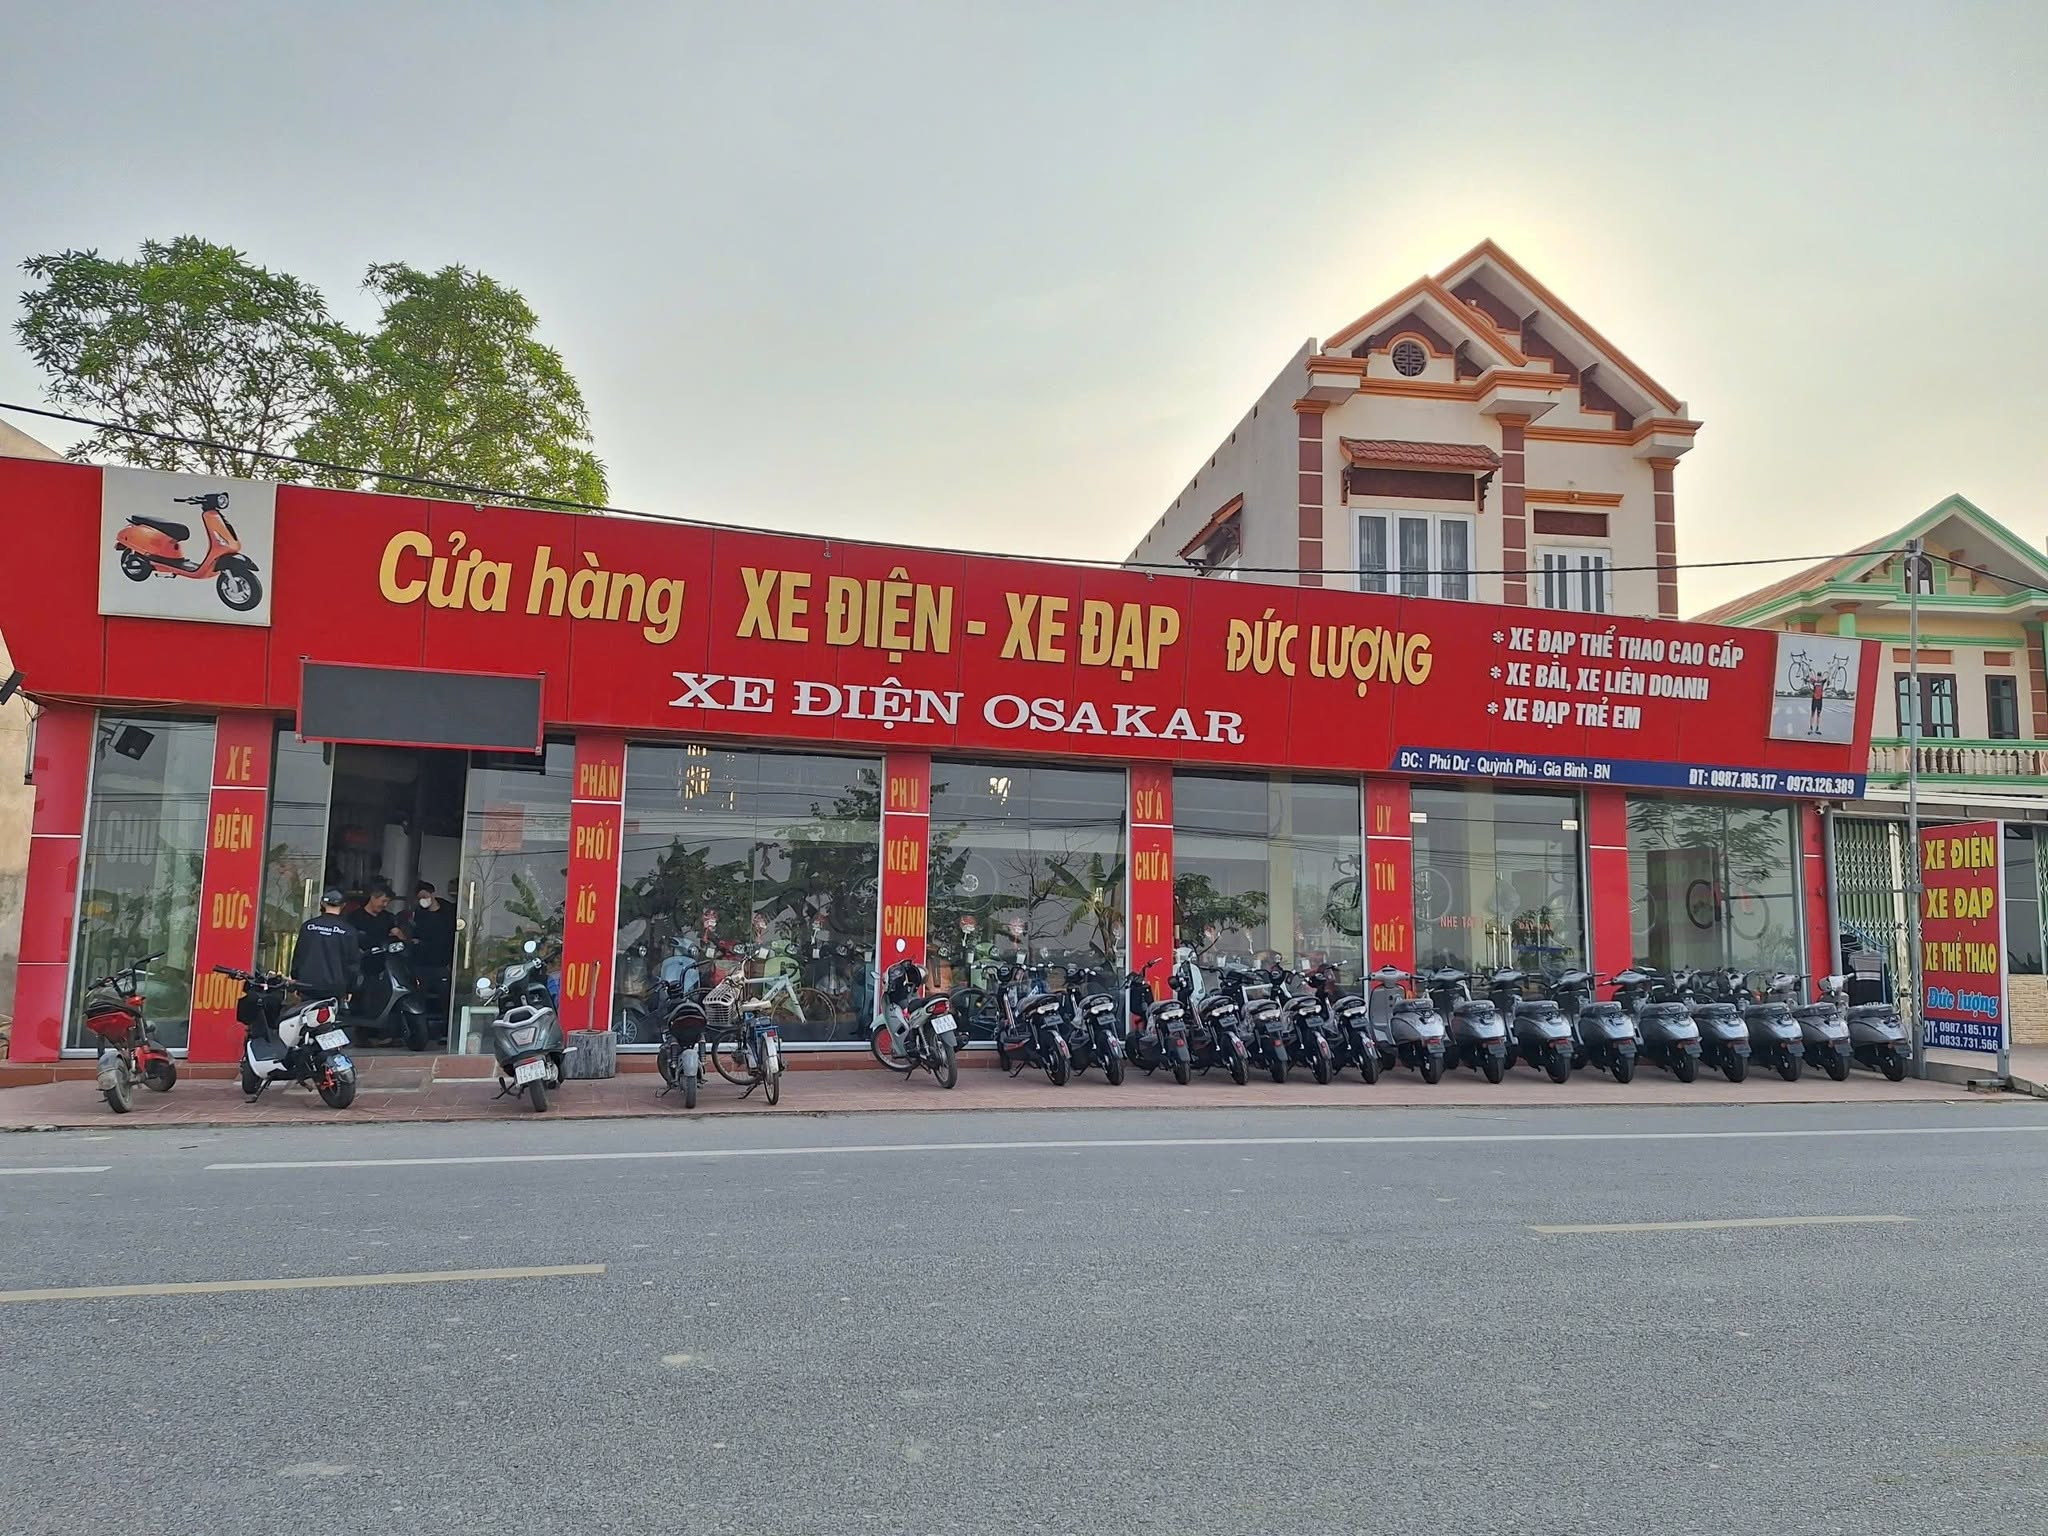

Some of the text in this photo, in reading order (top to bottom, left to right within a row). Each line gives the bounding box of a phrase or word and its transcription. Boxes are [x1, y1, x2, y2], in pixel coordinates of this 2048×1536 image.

[379, 530, 513, 612] Cửa
[525, 545, 685, 644] hàng
[736, 567, 811, 642] XE
[825, 566, 954, 663] ĐIỆN
[999, 592, 1069, 663] XE
[1079, 599, 1180, 682] ĐẠP
[1226, 607, 1298, 677] ĐỨC
[1309, 624, 1433, 698] LƯỢNG
[1508, 625, 1744, 669] XE ĐẠP THỂ THAO CAO CẤP
[1505, 662, 1532, 687] XE
[1576, 667, 1602, 692] XE
[1604, 666, 1646, 696] LIÊN
[1648, 674, 1709, 701] DOANH
[669, 671, 1245, 744] XE ĐIỆN OSAKAR
[1503, 696, 1641, 730] XE ĐẠP TRẺ EM
[225, 745, 253, 781] XE
[579, 759, 620, 798] PHÂN
[1400, 751, 1423, 768] ĐC:
[1428, 753, 1451, 770] Phú
[1452, 754, 1470, 771] Dư
[1477, 756, 1514, 777] Quỳnh
[1515, 758, 1537, 775] Phú
[1543, 760, 1562, 777] Gia
[1563, 763, 1588, 779] Bình
[1593, 763, 1611, 780] BN
[1689, 768, 1709, 786] ĐT:
[1710, 769, 1778, 791] 0987.185.117
[1786, 775, 1855, 795] 0973.126.389
[890, 777, 919, 812] PHỤ
[213, 807, 254, 852] ĐIỆN
[1376, 804, 1392, 833] UY
[575, 819, 613, 861] PHỐI
[887, 835, 919, 875] KIỆN
[1925, 830, 1995, 876] XE ĐIỆN
[1135, 843, 1169, 882] CHỮA
[1374, 857, 1396, 891] TÍN
[212, 886, 251, 930] ĐỨC
[576, 883, 597, 924] ẮC
[884, 900, 925, 937] CHÍNH
[1926, 886, 1994, 927] XE ĐẠP
[1136, 913, 1159, 948] TẠI
[1373, 915, 1406, 953] CHẤT
[1925, 931, 1997, 975] XE THỂ THAO
[1927, 987, 1999, 1018] Đức lượng
[1939, 1021, 1999, 1037] 0987.185.117
[1939, 1034, 1999, 1051] 0833.731.566
